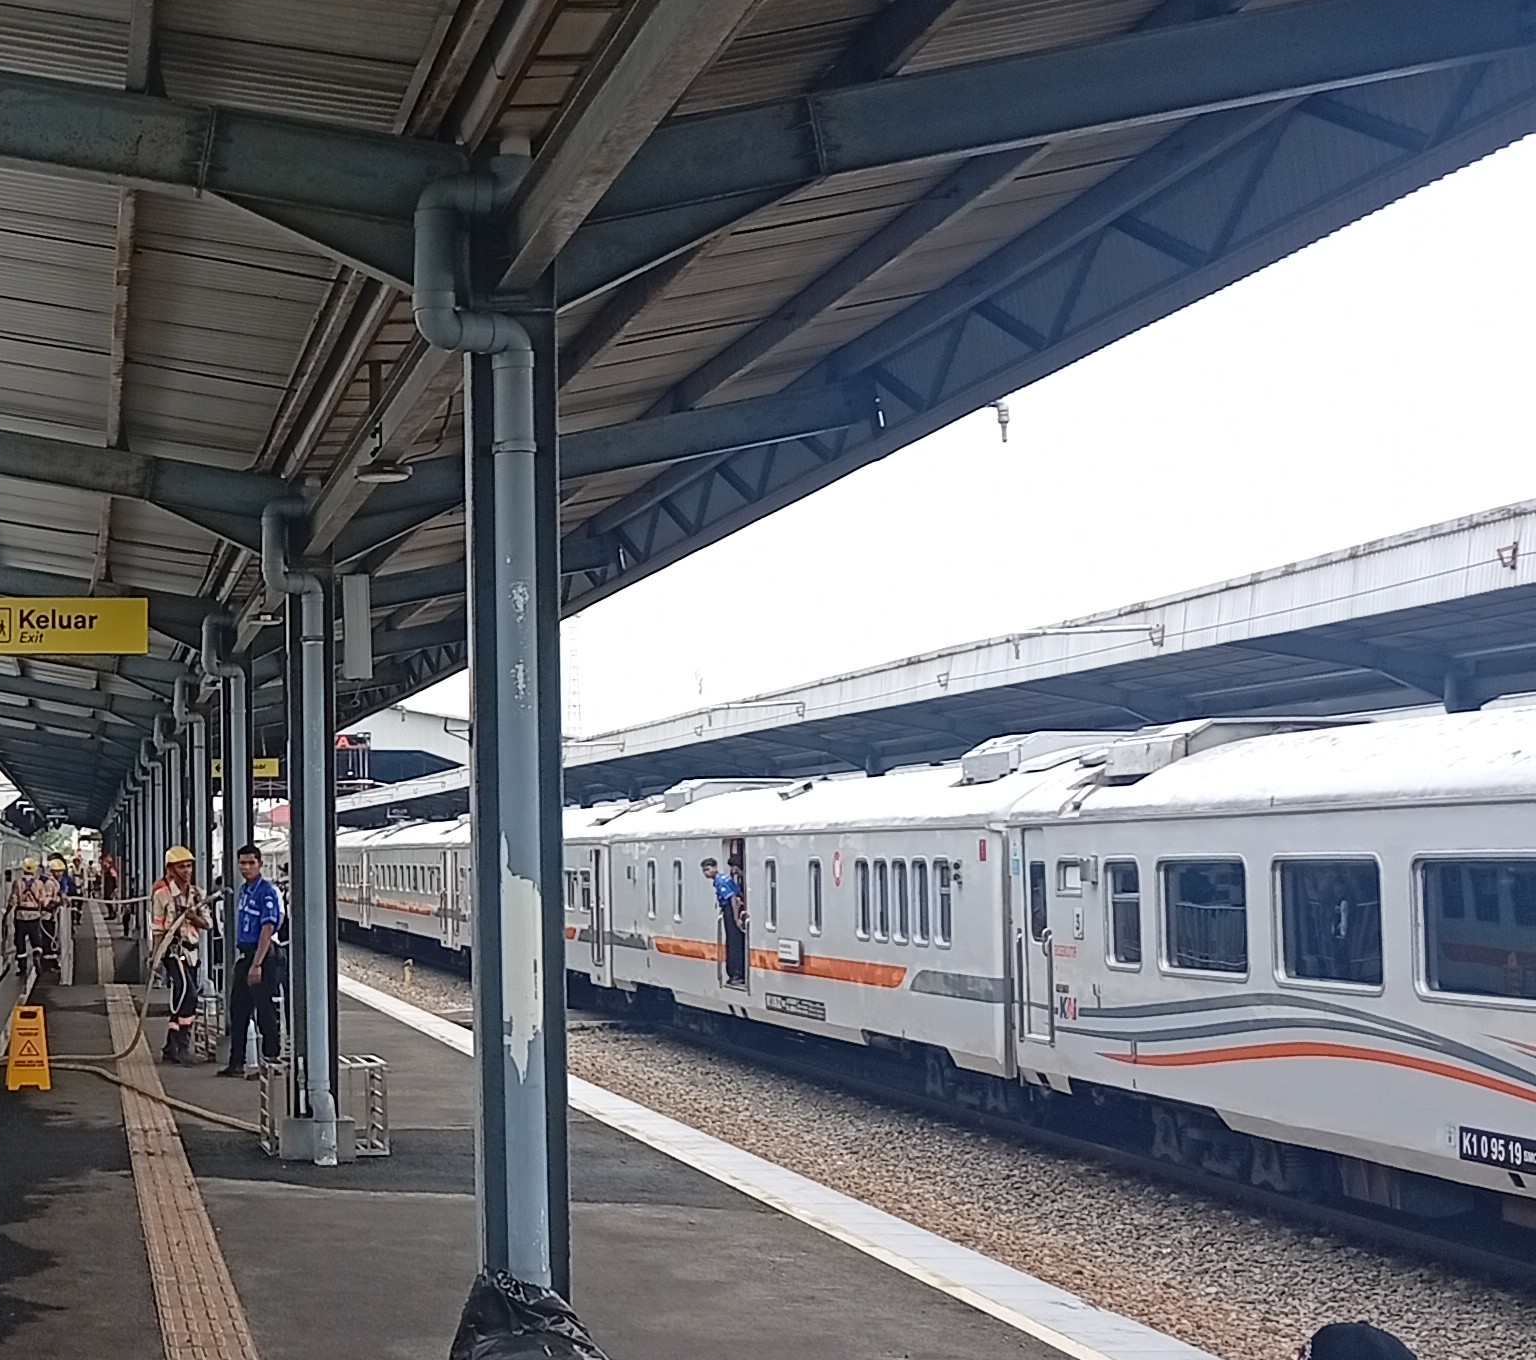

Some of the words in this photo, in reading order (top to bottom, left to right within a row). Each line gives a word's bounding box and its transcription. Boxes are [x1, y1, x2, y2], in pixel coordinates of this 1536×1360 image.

[19, 608, 98, 630] Keluar
[19, 631, 44, 644] Exit
[1462, 1131, 1478, 1156] K1
[1480, 1135, 1489, 1159] 0
[1490, 1137, 1505, 1162] 95
[1508, 1140, 1522, 1165] 19
